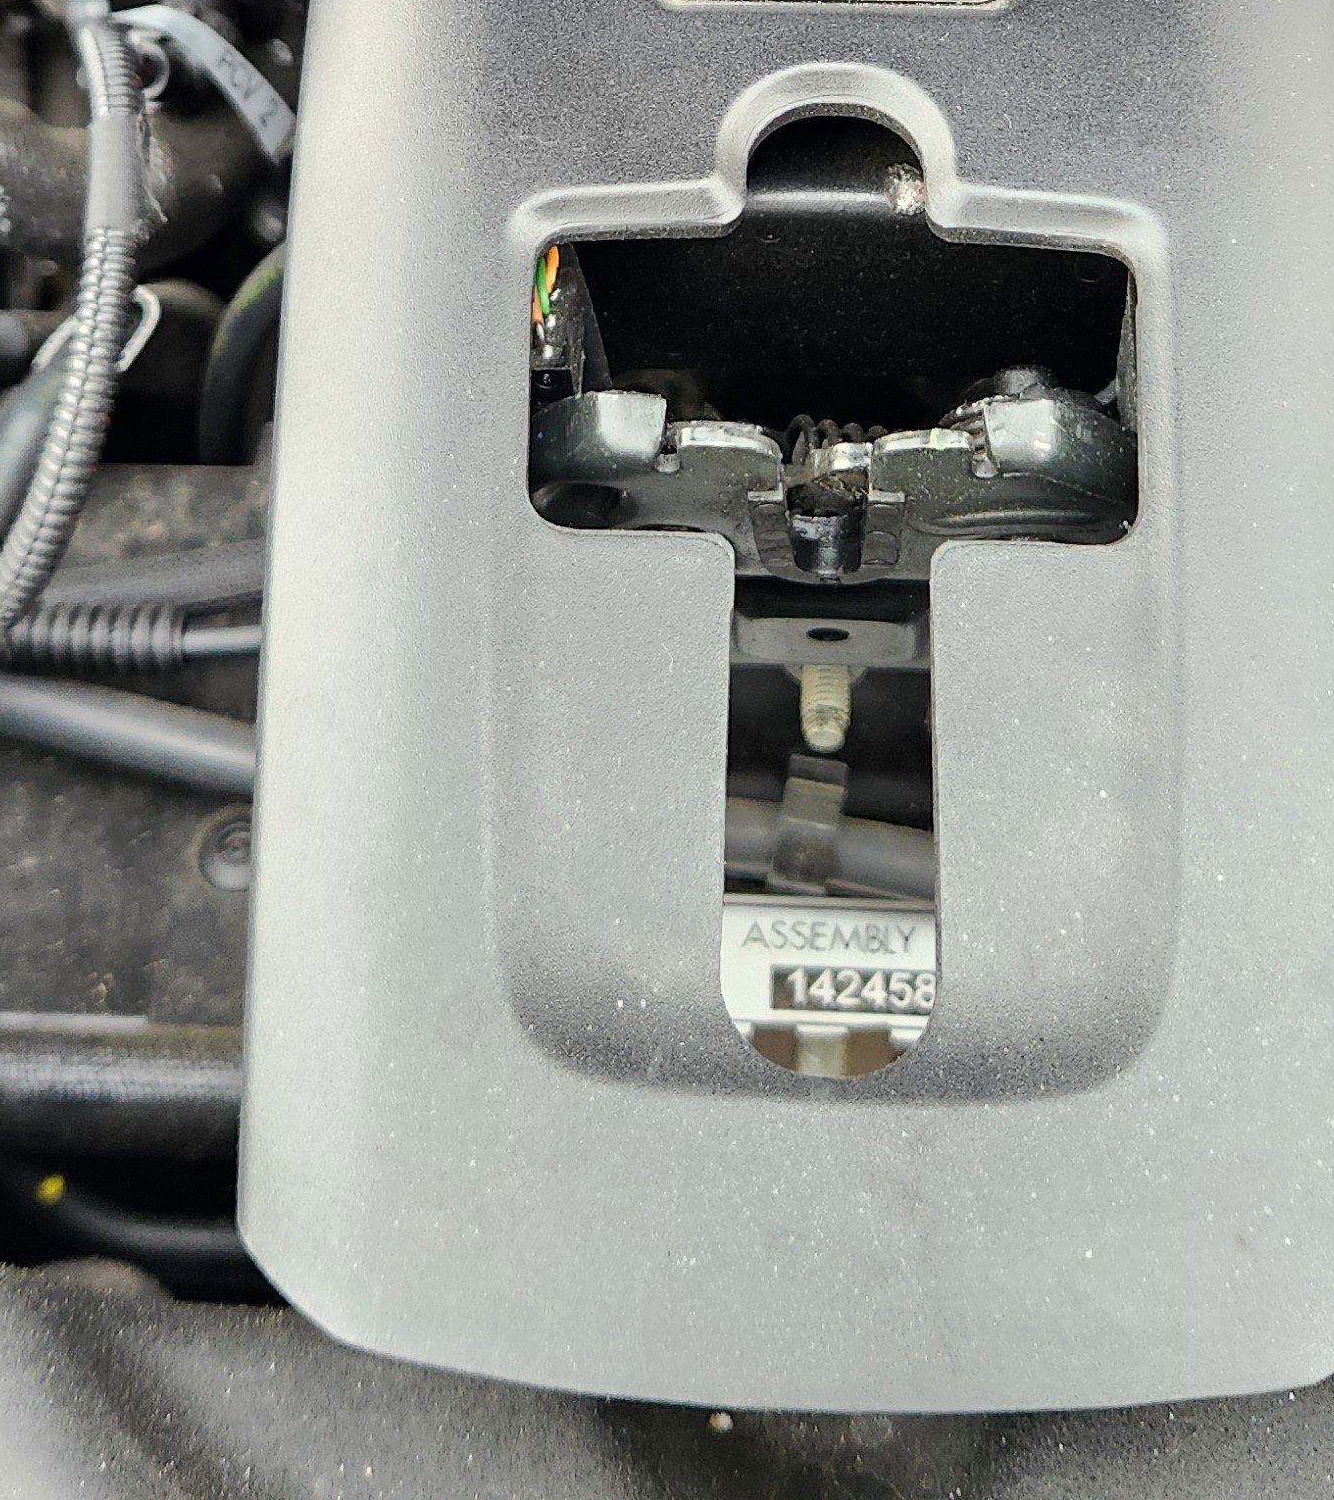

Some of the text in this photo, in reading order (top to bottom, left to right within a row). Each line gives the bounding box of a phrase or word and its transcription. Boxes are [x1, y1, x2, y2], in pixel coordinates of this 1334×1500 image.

[218, 49, 279, 127] PCV 2
[741, 919, 916, 955] ASSEMBLY
[787, 967, 936, 1008] 142458
